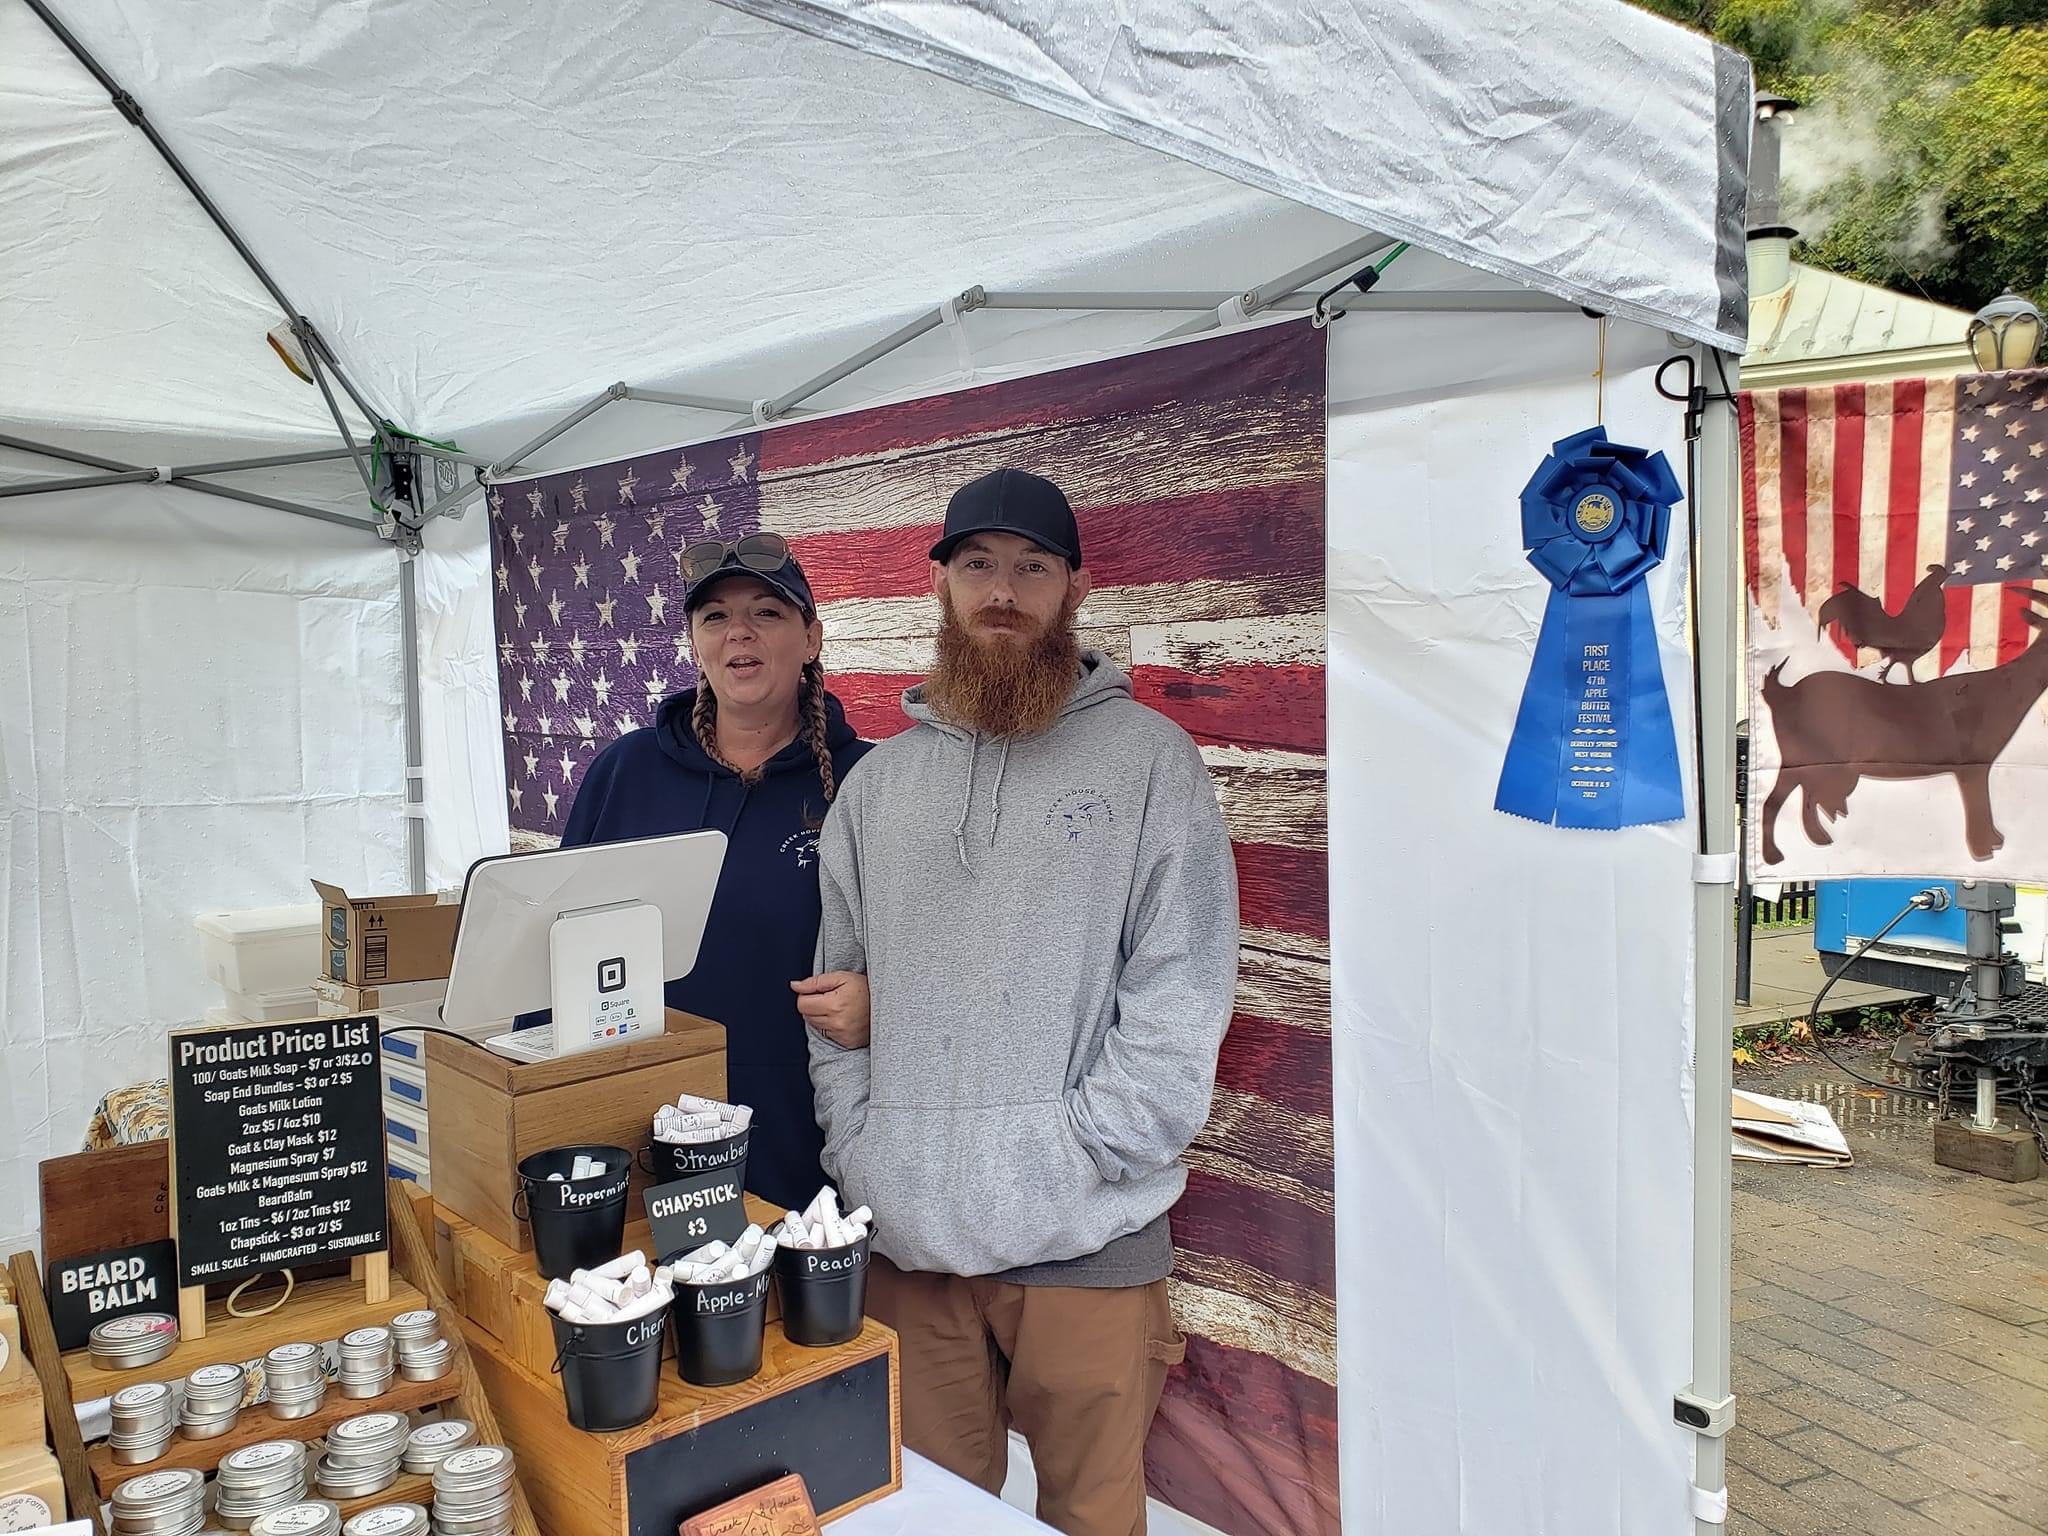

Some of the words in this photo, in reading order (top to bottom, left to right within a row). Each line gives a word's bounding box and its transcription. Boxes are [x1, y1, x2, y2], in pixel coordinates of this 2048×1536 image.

[1584, 645, 1609, 657] FIRST
[1582, 660, 1611, 672] PLACE
[1586, 675, 1606, 685] 47th
[1584, 688, 1608, 698] APPLE
[1581, 701, 1611, 711] BUTTER
[1578, 713, 1613, 723] FESTIVAL
[1065, 788, 1096, 798] HOUSE
[610, 999, 630, 1009] Square
[180, 1033, 267, 1067] Product
[272, 1029, 326, 1054] Price
[332, 1022, 370, 1049] List
[220, 1068, 248, 1081] Goats
[250, 1065, 272, 1078] Milk
[273, 1062, 298, 1077] Soap
[308, 1057, 321, 1072] $7
[323, 1057, 333, 1068] or
[335, 1052, 373, 1067] 3/$20
[204, 1090, 230, 1104] Soap
[233, 1086, 252, 1099] End
[254, 1080, 294, 1096] Bundles
[304, 1076, 317, 1090] $3
[318, 1076, 330, 1088] or
[331, 1073, 338, 1085] 2
[340, 1071, 352, 1084] $5
[238, 1104, 267, 1117] Goats
[269, 1100, 290, 1113] Milk
[292, 1096, 323, 1110] Lotion
[242, 1122, 260, 1136] 2oz
[262, 1119, 276, 1134] $5
[283, 1116, 300, 1128] 4oz
[302, 1112, 321, 1128] $10
[228, 1143, 251, 1156] Goat
[253, 1141, 261, 1152] &
[263, 1136, 285, 1151] Clay
[287, 1134, 314, 1147] Mask
[318, 1128, 338, 1144] $12
[230, 1157, 288, 1176] Magnesium
[290, 1151, 319, 1167] Spray
[322, 1146, 336, 1161] $7
[196, 1185, 226, 1199] Goats
[228, 1180, 250, 1194] Milk
[252, 1176, 261, 1190] &
[262, 1169, 319, 1189] Magnesium
[321, 1165, 349, 1182] Spray
[350, 1160, 368, 1176] $12
[560, 1170, 630, 1206] Peppermint
[258, 1189, 312, 1208] BeardBalm
[652, 1183, 738, 1218] CHAPSTICK
[218, 1220, 237, 1234] 1oz
[239, 1216, 260, 1230] Tins
[270, 1212, 284, 1226] $6
[292, 1208, 309, 1221] 2oz
[310, 1204, 331, 1218] Tins
[332, 1199, 351, 1214] $12
[688, 1217, 708, 1237] $3
[230, 1232, 280, 1250] Chapstick
[290, 1226, 304, 1240] $3
[306, 1226, 316, 1237] or
[330, 1219, 342, 1234] $5
[190, 1261, 220, 1276] SMALL
[222, 1256, 249, 1270] SCALE
[260, 1244, 317, 1263] HANDCRAFTED
[328, 1231, 382, 1250] SUSTAINABLE
[807, 1249, 862, 1272] Peach
[61, 1256, 146, 1294] BEARD
[88, 1277, 157, 1314] BALM
[0, 1498, 24, 1510] ouse
[770, 1495, 800, 1515] House
